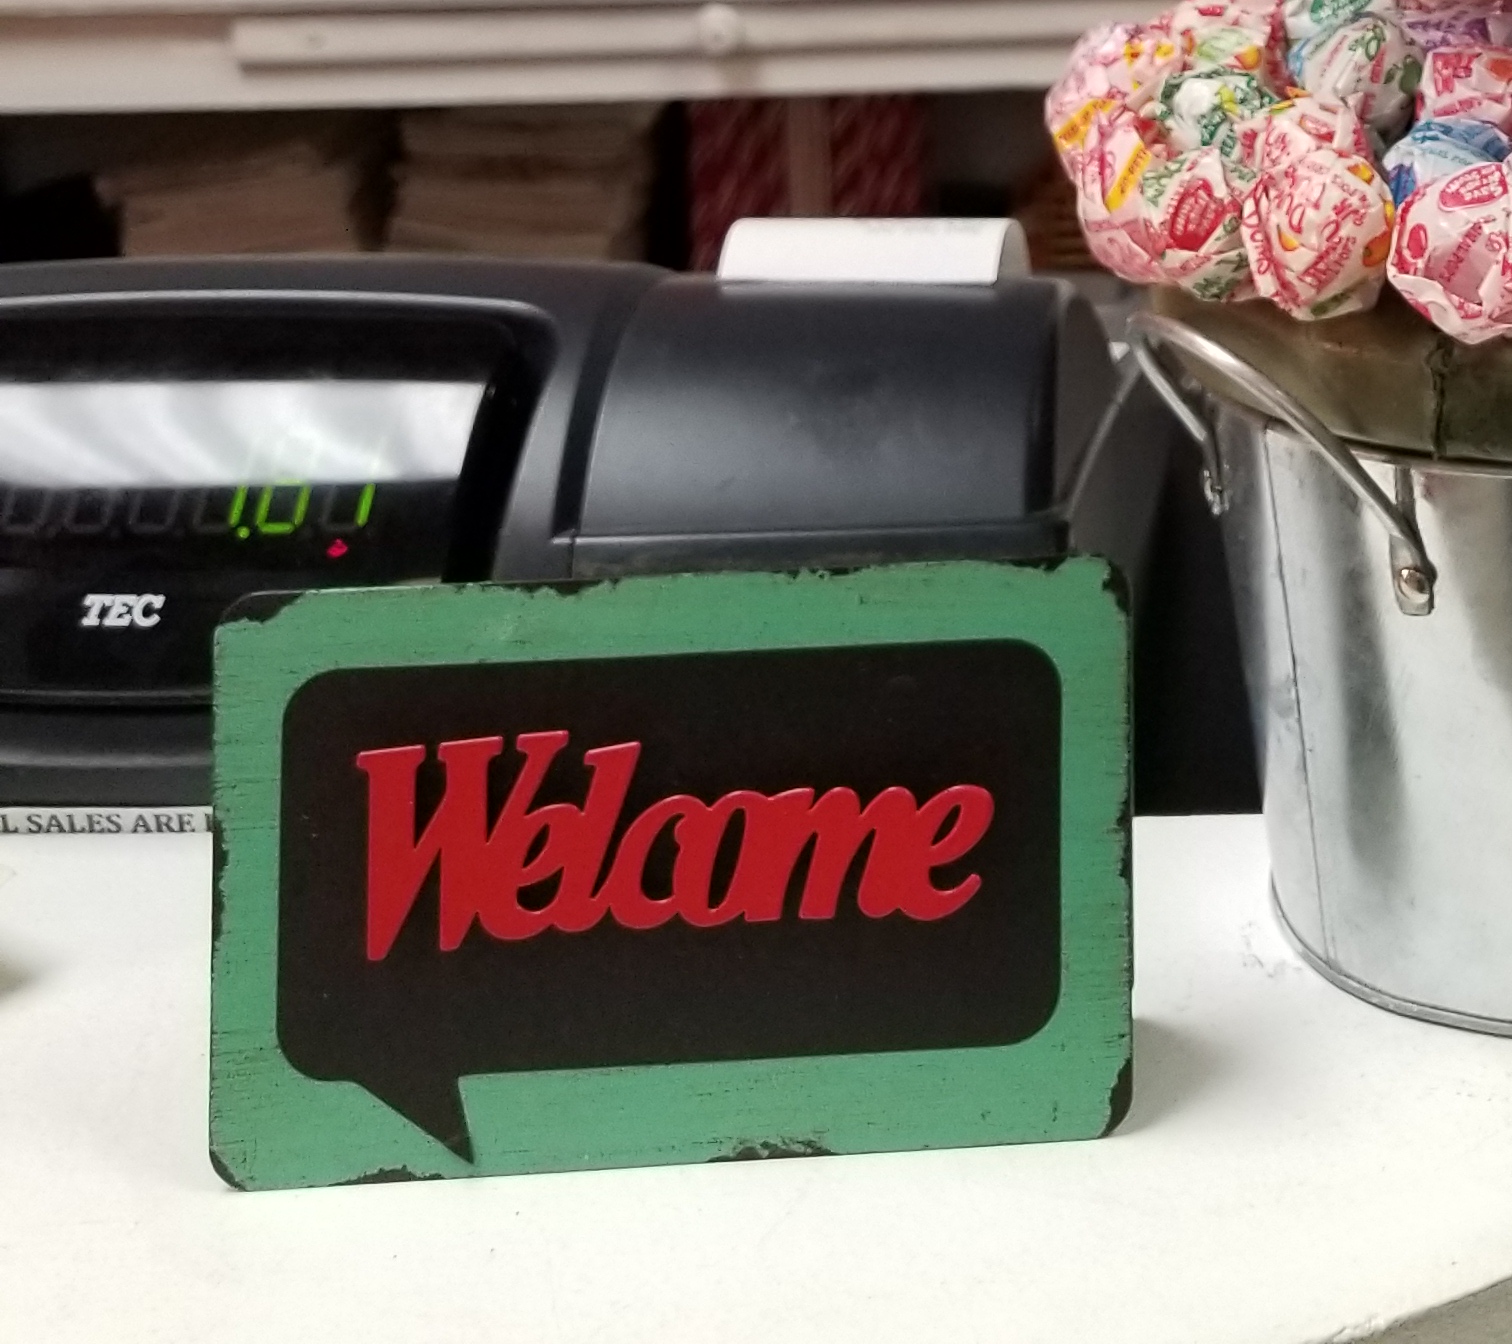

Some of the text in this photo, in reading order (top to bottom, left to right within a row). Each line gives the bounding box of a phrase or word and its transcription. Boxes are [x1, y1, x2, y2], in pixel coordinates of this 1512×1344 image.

[80, 593, 166, 627] TEC
[26, 813, 122, 834] SALES
[131, 813, 196, 833] ARE
[355, 729, 997, 963] Welcome
